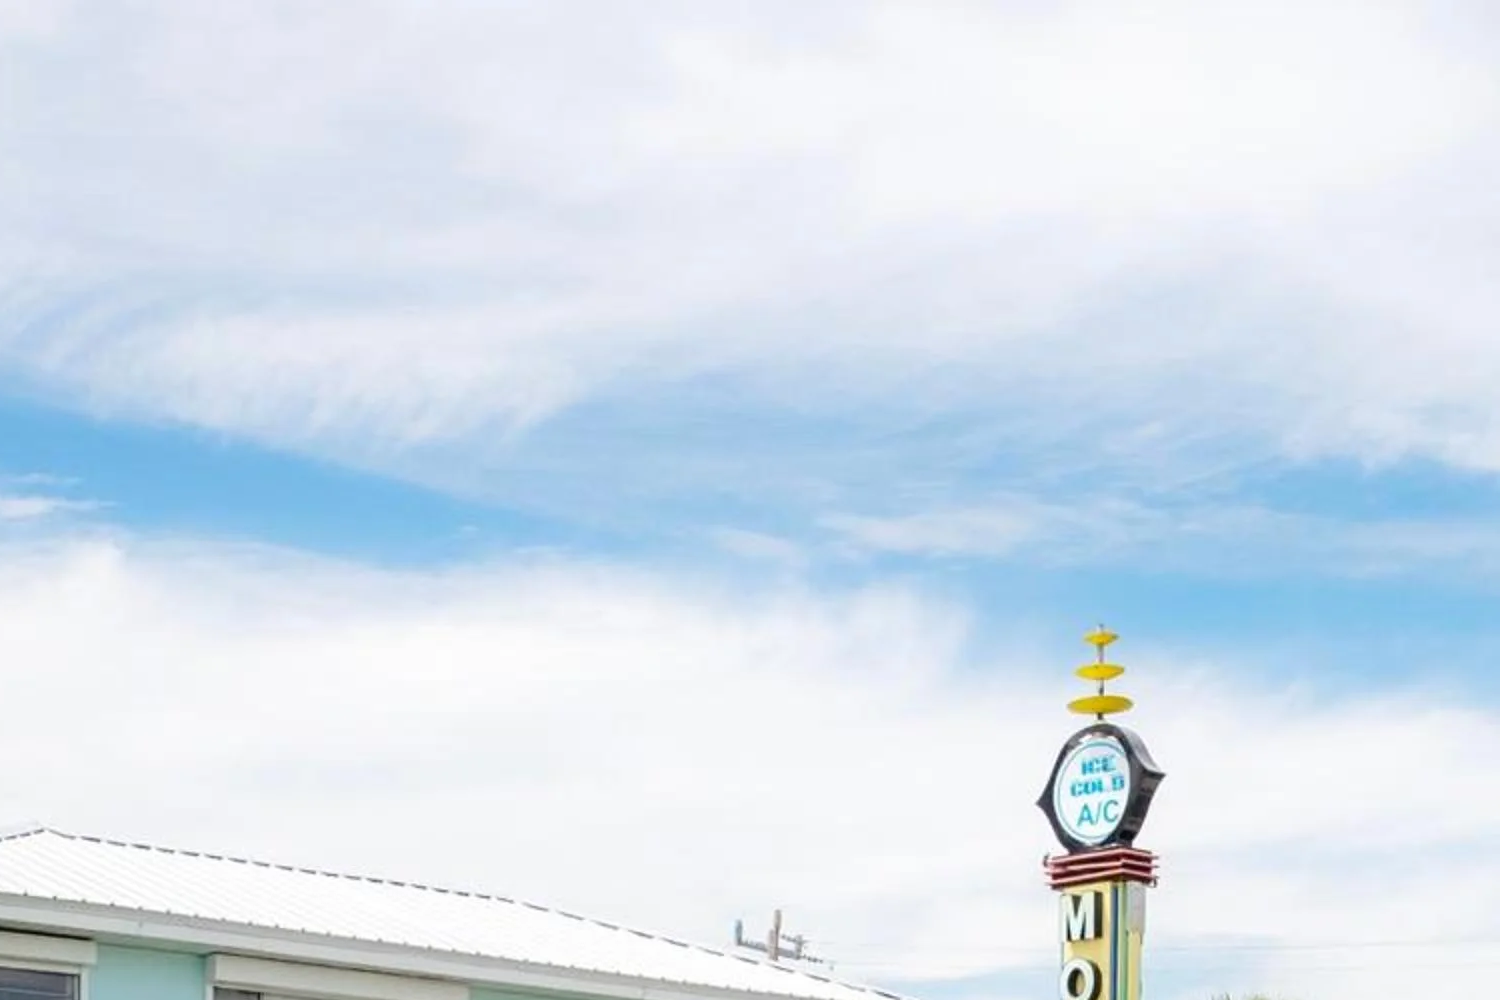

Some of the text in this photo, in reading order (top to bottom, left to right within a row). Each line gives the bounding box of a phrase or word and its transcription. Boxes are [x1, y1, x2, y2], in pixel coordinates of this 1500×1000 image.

[1082, 755, 1117, 776] ICE
[1070, 776, 1125, 796] COLD
[1076, 799, 1119, 827] A/C
